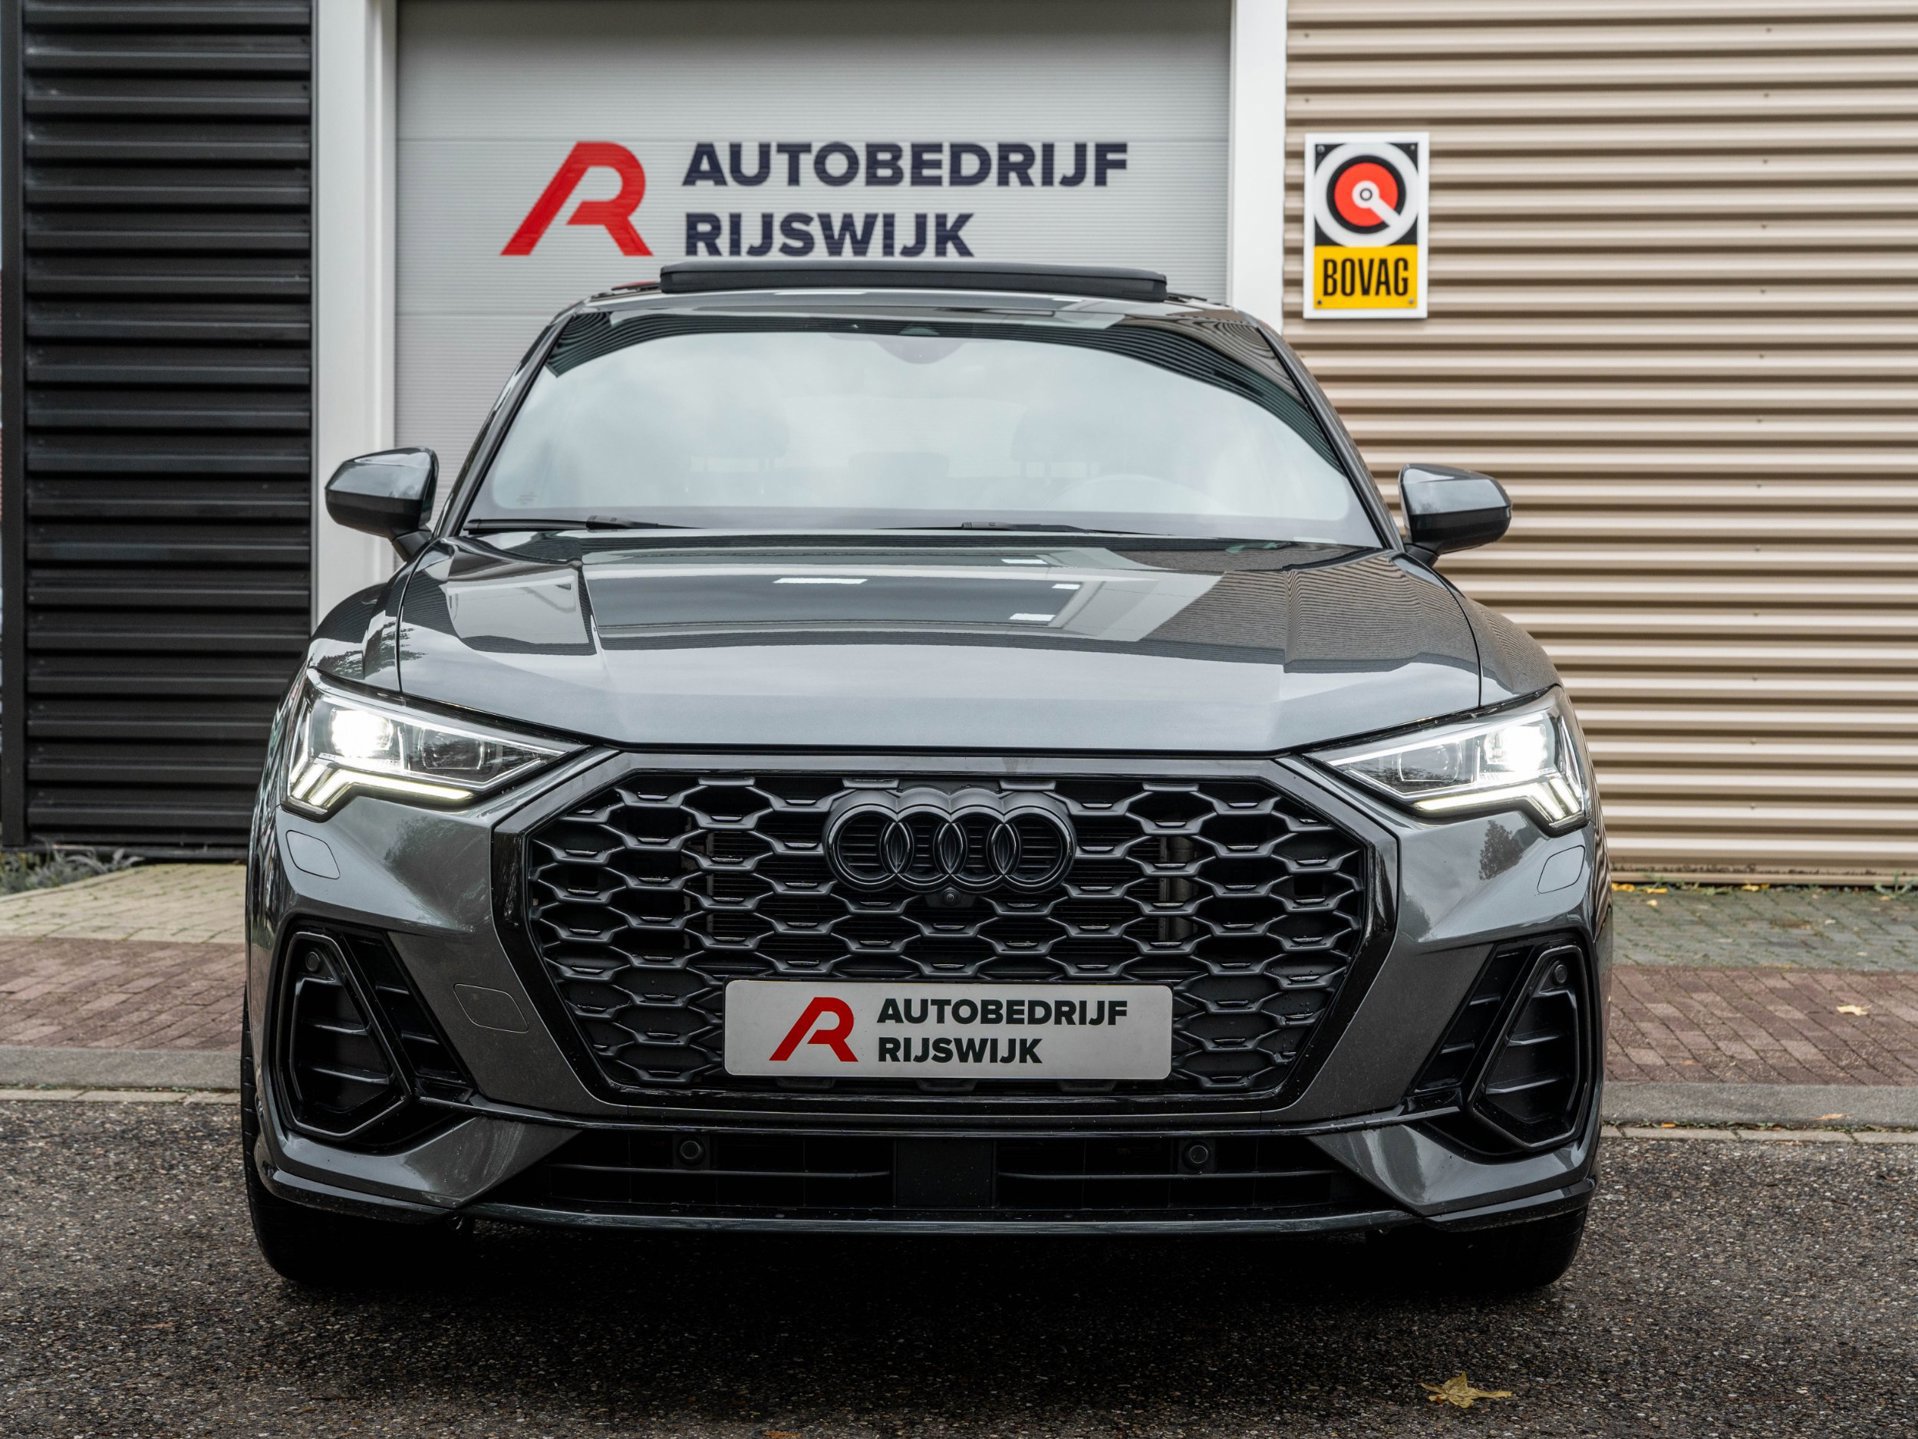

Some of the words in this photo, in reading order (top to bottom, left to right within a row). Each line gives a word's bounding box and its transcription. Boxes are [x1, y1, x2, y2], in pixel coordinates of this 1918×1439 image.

[682, 142, 1128, 188] AUTOBEDRIJF
[685, 212, 975, 257] RIJSWIJK
[1323, 258, 1409, 297] BOVAG
[877, 998, 1128, 1026] AUTOBEDRIJF
[878, 1036, 1043, 1064] RIJSWIJK
